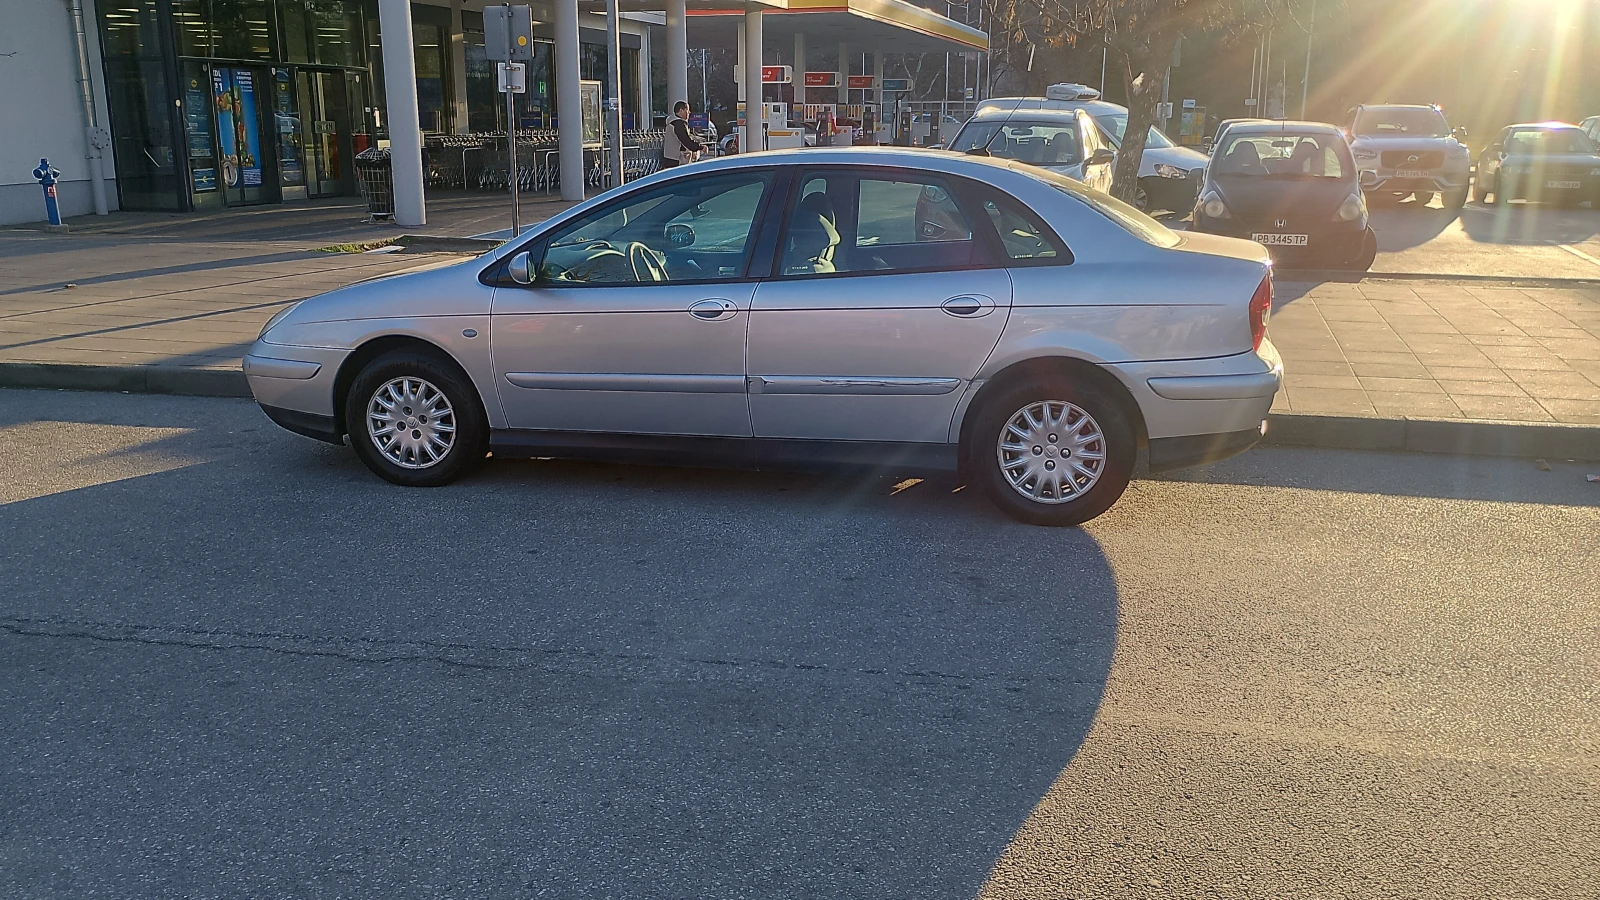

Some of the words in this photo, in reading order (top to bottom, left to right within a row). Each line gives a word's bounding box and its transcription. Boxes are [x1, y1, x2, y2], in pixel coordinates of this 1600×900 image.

[1257, 234, 1269, 243] PB
[1270, 235, 1292, 244] 3445
[1294, 235, 1307, 245] TP
